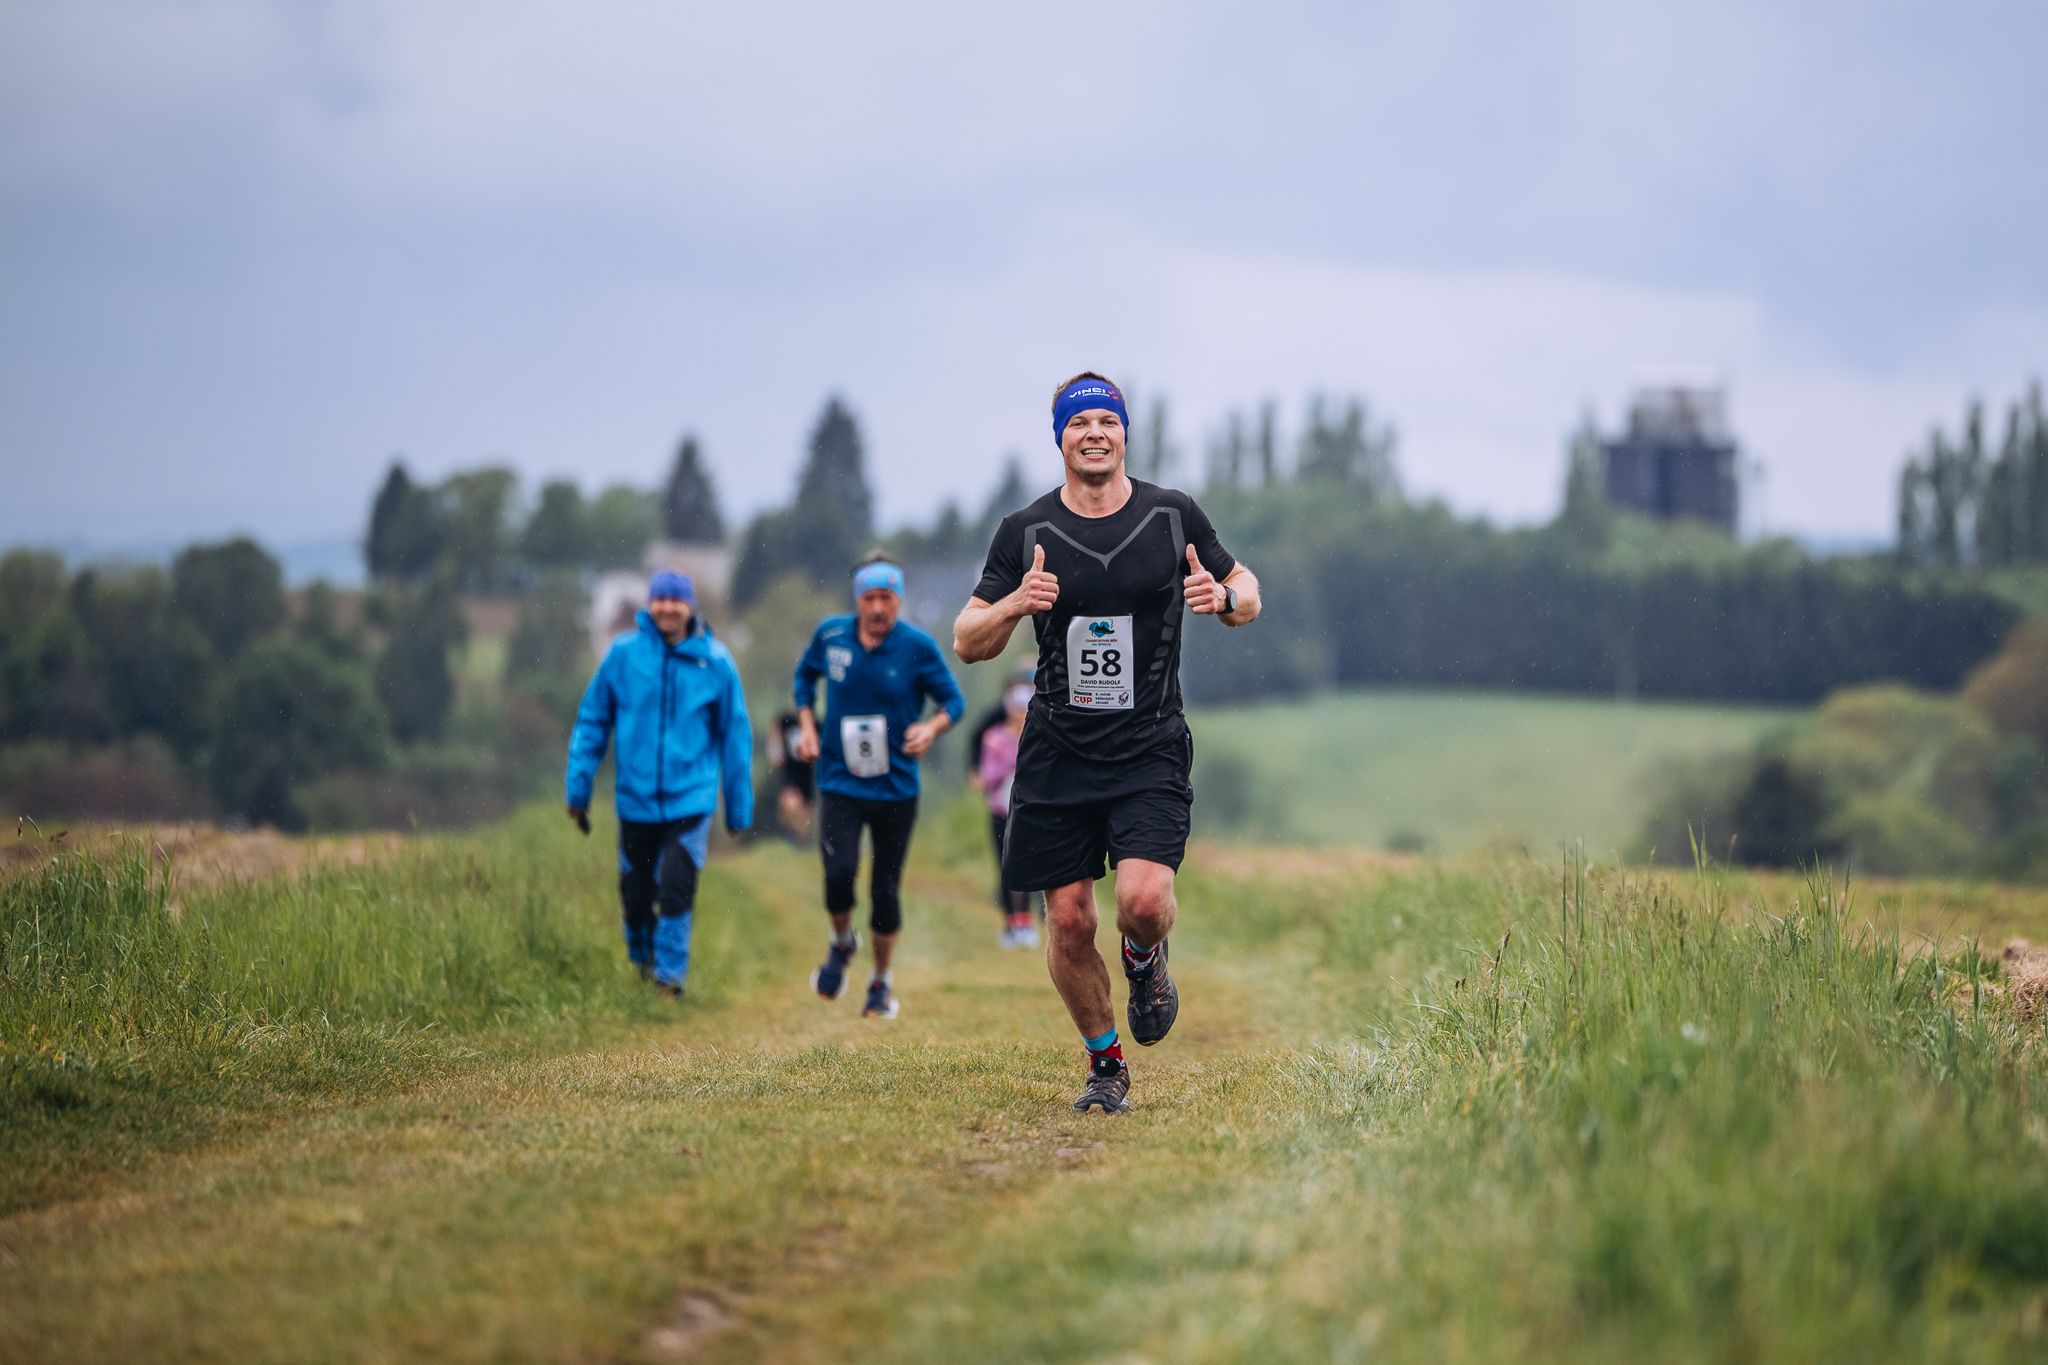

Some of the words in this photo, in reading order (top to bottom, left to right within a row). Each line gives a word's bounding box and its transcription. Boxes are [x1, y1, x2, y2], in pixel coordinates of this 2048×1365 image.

[1069, 387, 1106, 398] VINCI
[1080, 649, 1122, 677] 58
[1074, 696, 1092, 704] CUP
